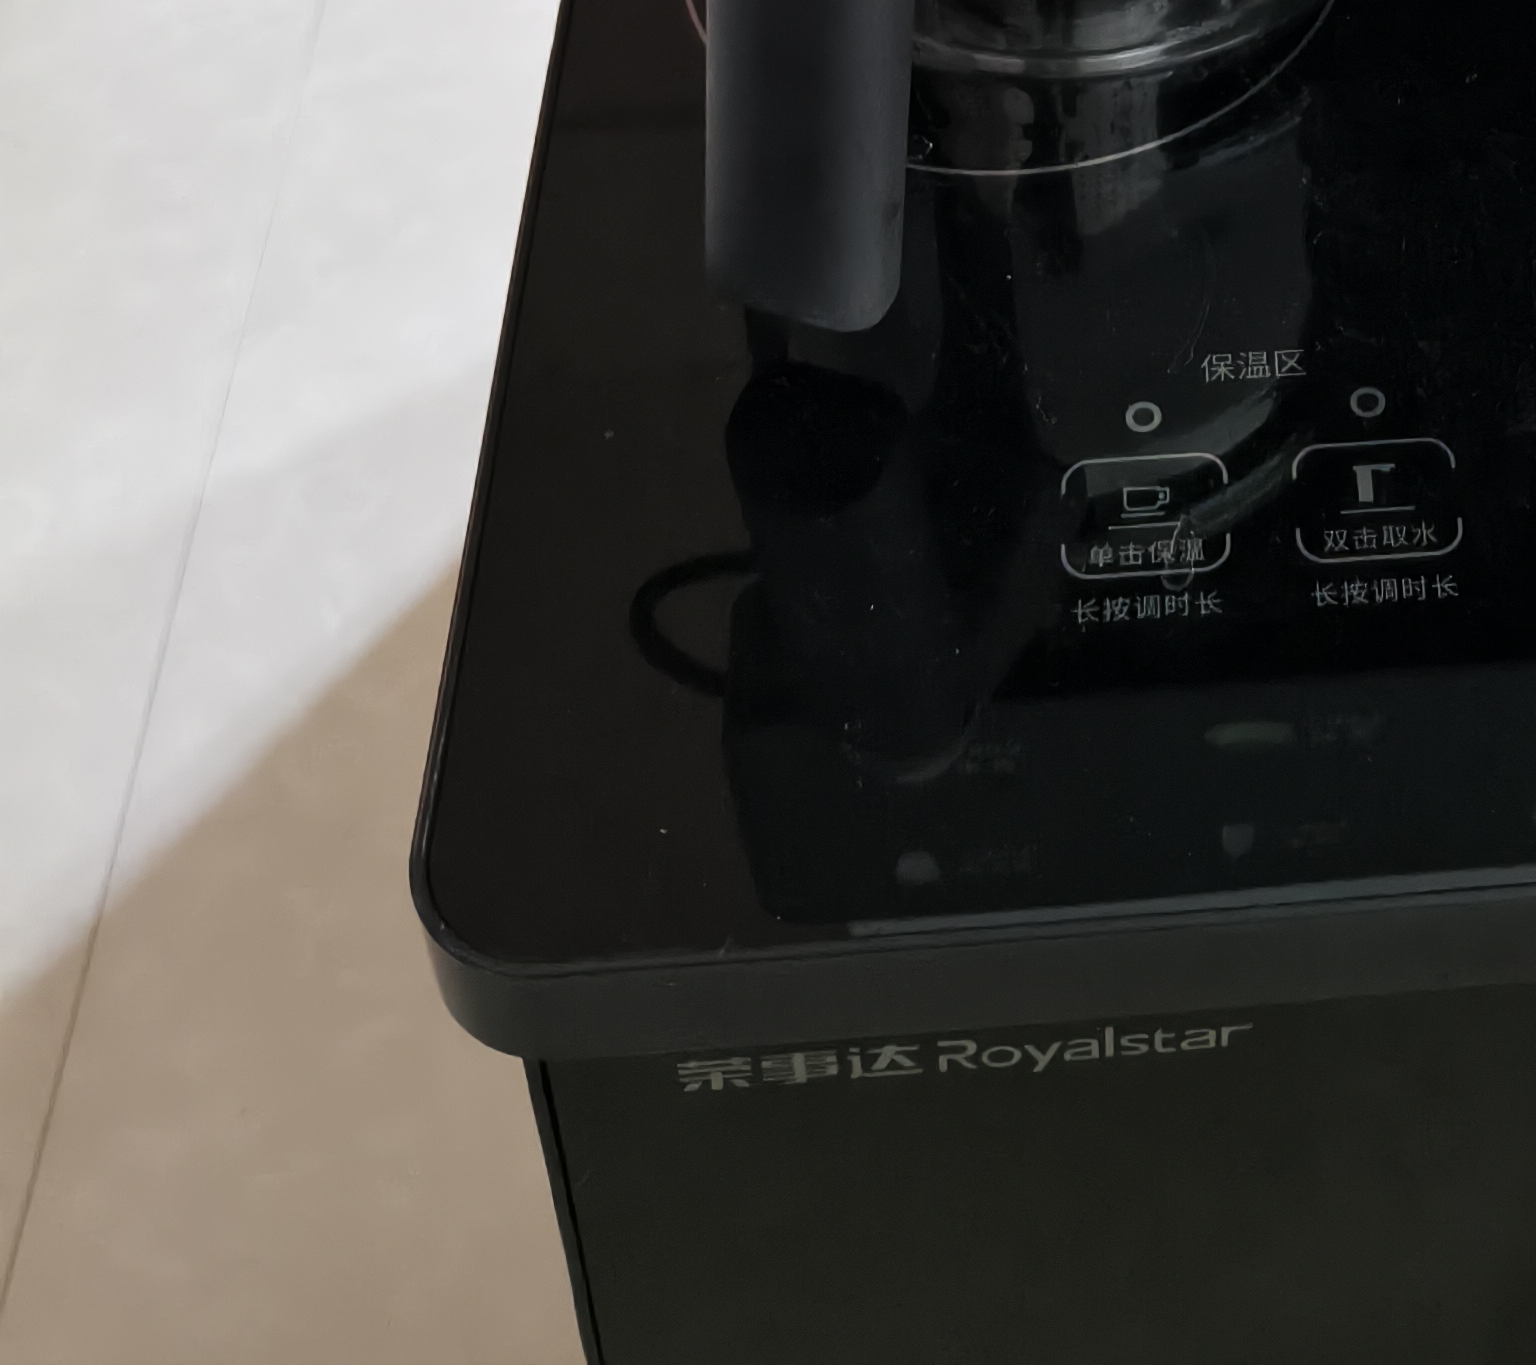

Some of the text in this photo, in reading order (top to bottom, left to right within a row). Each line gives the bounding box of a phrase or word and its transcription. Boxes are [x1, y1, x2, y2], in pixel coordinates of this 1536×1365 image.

[1201, 349, 1307, 382] 保温区
[1323, 521, 1439, 553] 双击取水
[1071, 590, 1225, 625] 长按调时长
[1311, 573, 1460, 608] 长按调时长
[937, 1022, 1254, 1074] Royalstar
